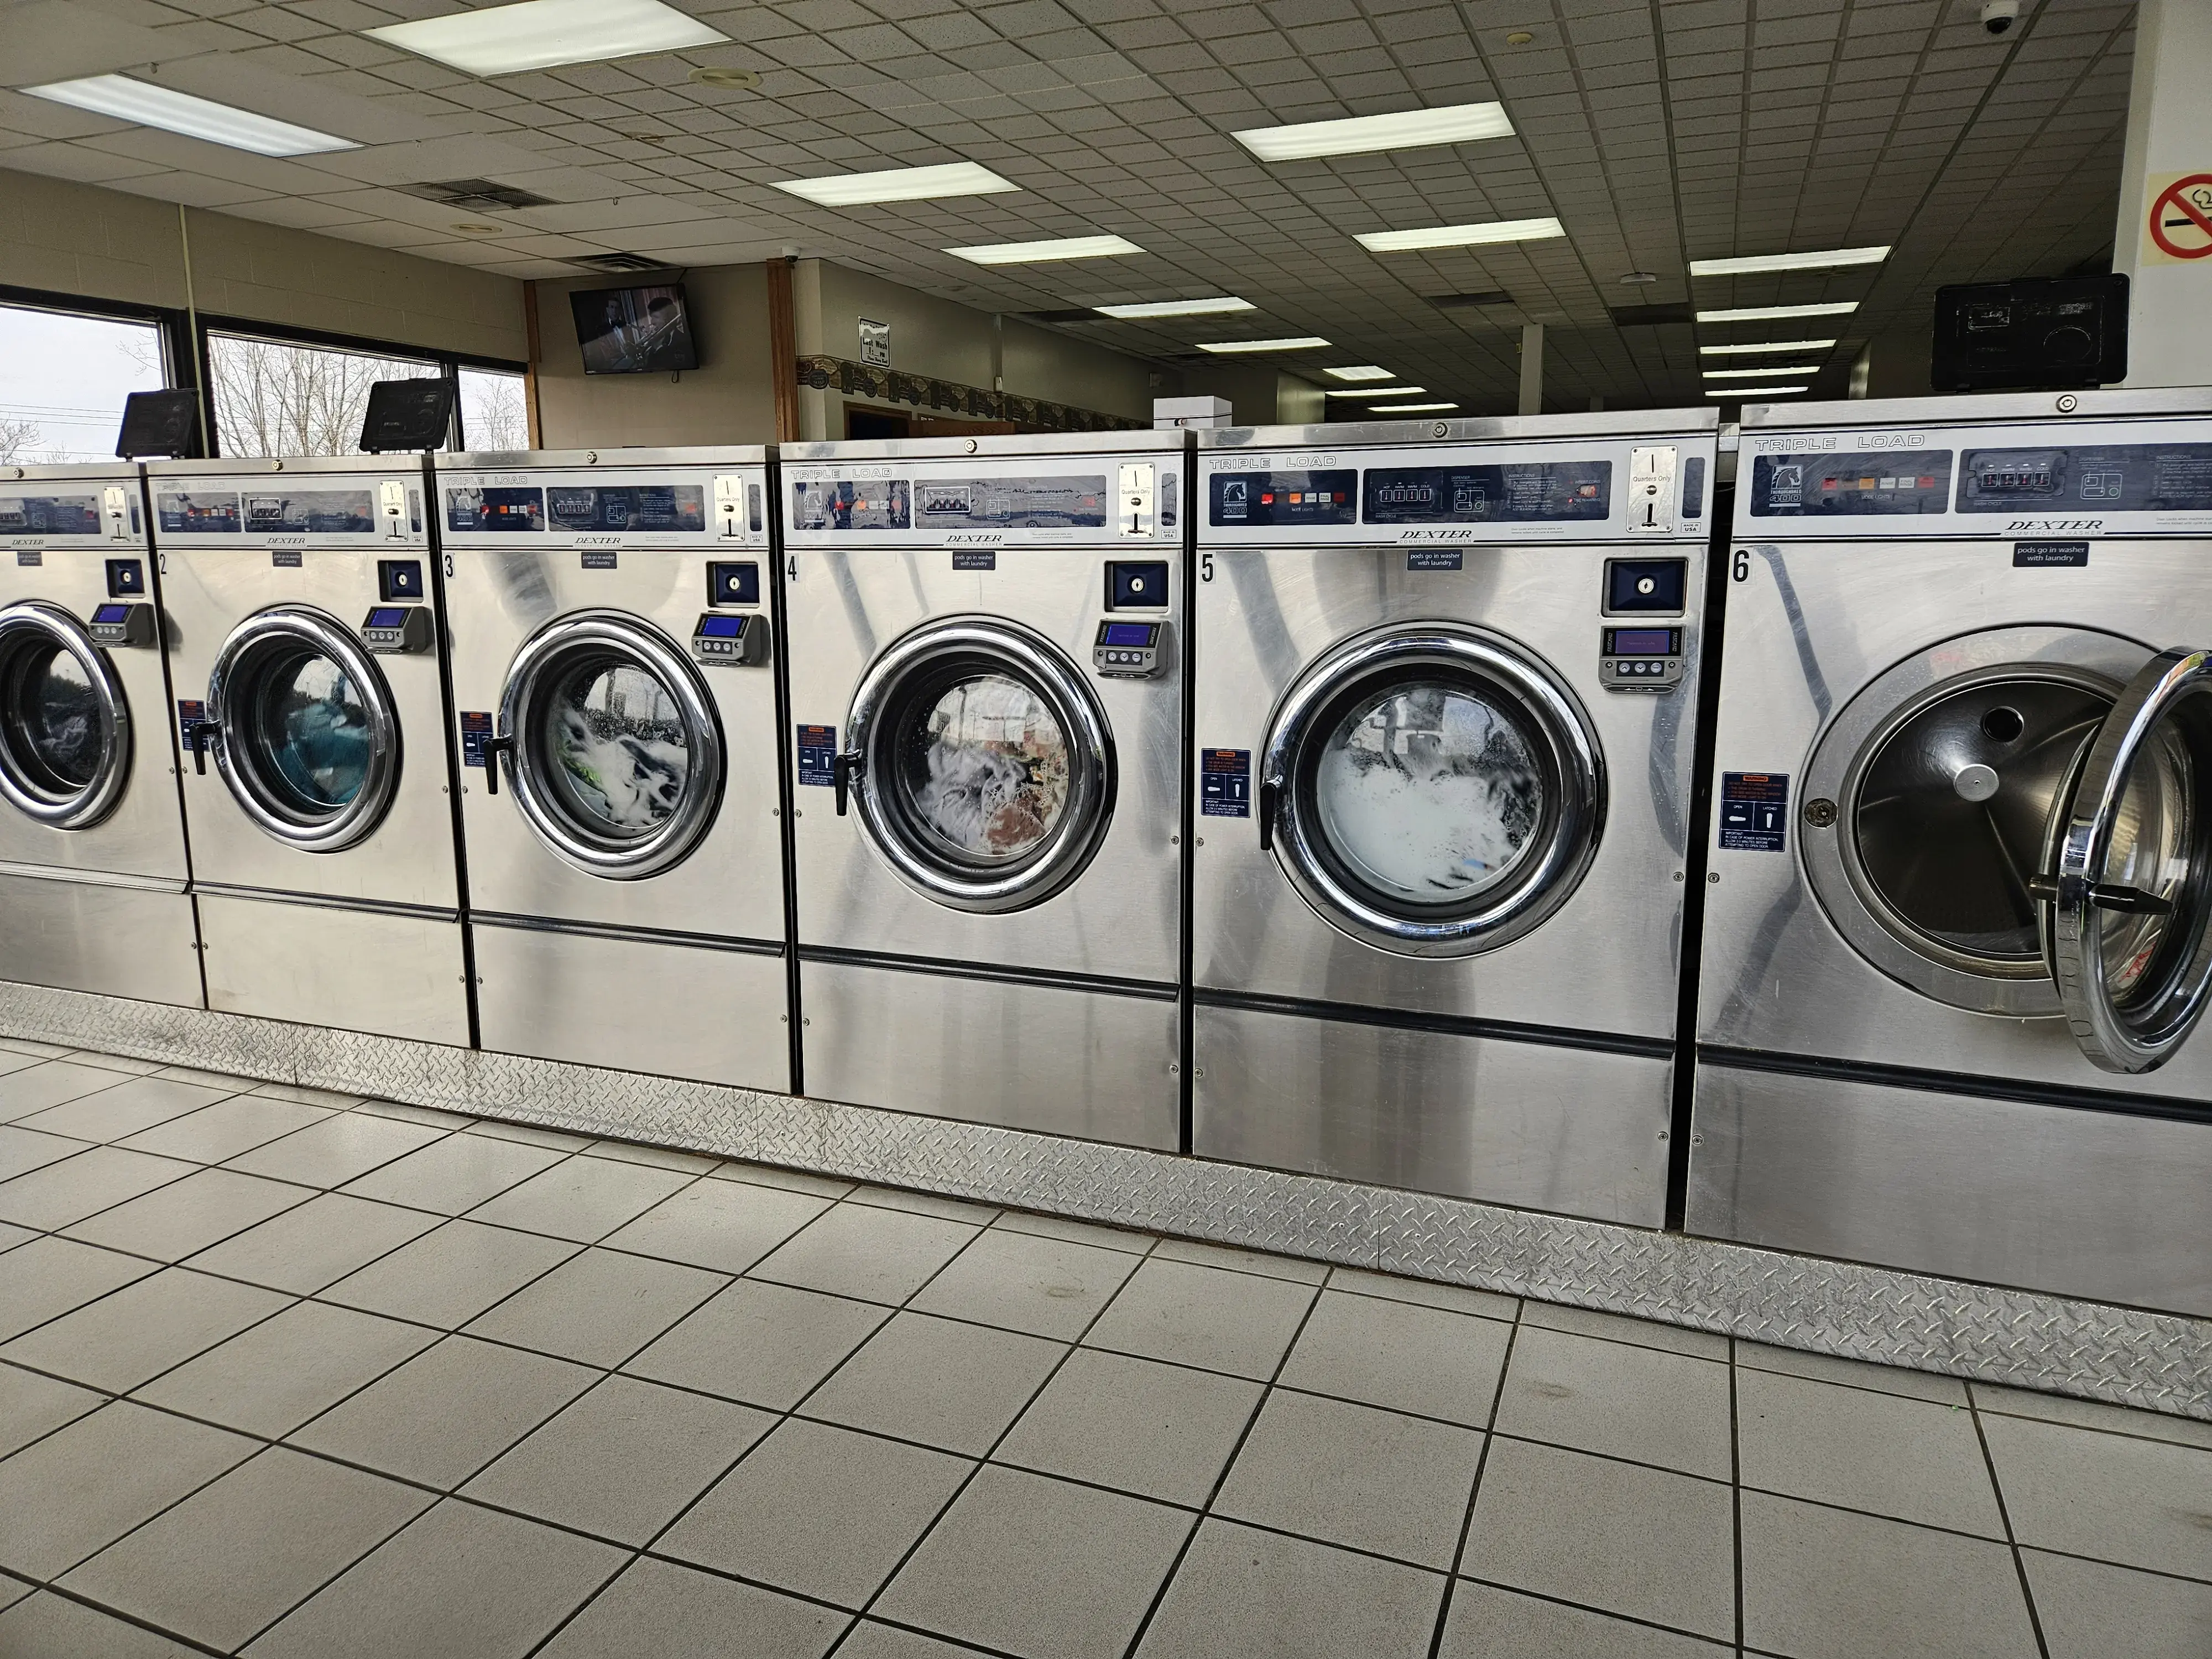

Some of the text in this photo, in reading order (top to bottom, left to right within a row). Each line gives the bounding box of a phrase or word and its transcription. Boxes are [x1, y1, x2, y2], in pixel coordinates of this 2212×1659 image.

[863, 337, 888, 350] Last Wash
[1755, 435, 1925, 451] TRIPLE LOAD
[1209, 456, 1336, 469] TRIPLE LOAD
[444, 476, 528, 486] TRIPLE LOAD
[791, 469, 892, 479] TRIPLE LOAD
[2005, 520, 2103, 530] DEXTER
[1400, 530, 1472, 539] DEXTER
[159, 554, 167, 575] 2
[445, 555, 453, 577] 3
[787, 556, 797, 581] 4
[1202, 554, 1213, 582] 5
[1733, 549, 1750, 582] 6
